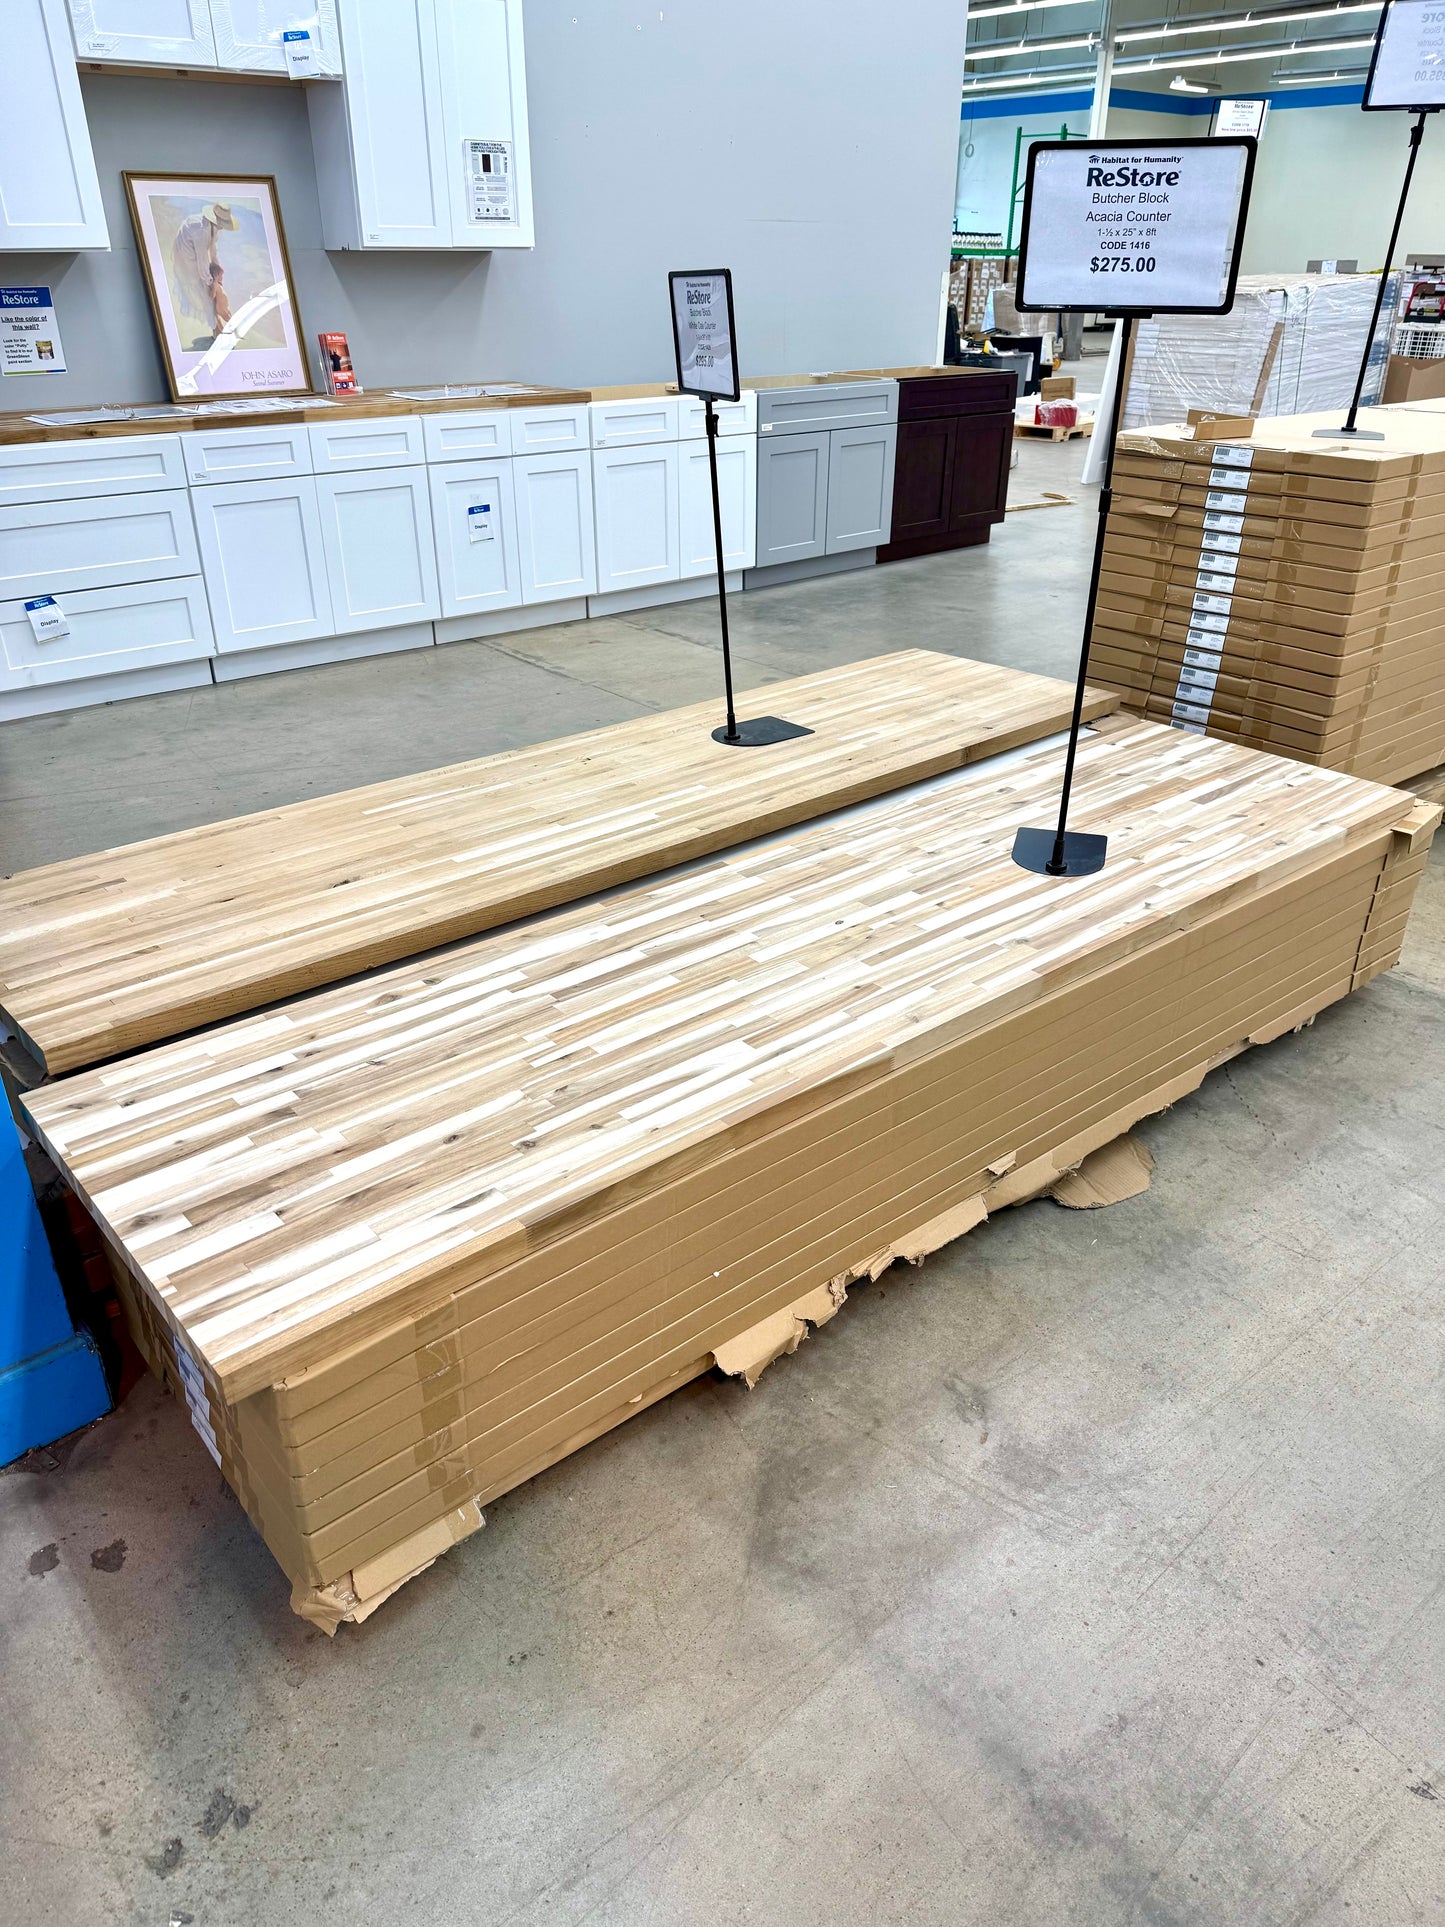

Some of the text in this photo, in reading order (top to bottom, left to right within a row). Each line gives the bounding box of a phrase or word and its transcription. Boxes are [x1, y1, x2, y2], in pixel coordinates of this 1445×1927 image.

[1101, 156, 1182, 165] Habitat for Humanity
[1086, 167, 1180, 187] ReStore
[1092, 192, 1170, 204] Butcher Block
[1085, 211, 1172, 222] Acacia Counter
[1146, 228, 1157, 236] 8ft
[1100, 241, 1150, 250] CODE 1416
[1090, 256, 1156, 274] $275.00
[2, 294, 39, 305] ReStore
[687, 290, 711, 305] ReStore
[241, 370, 293, 382] JOHN ASARO
